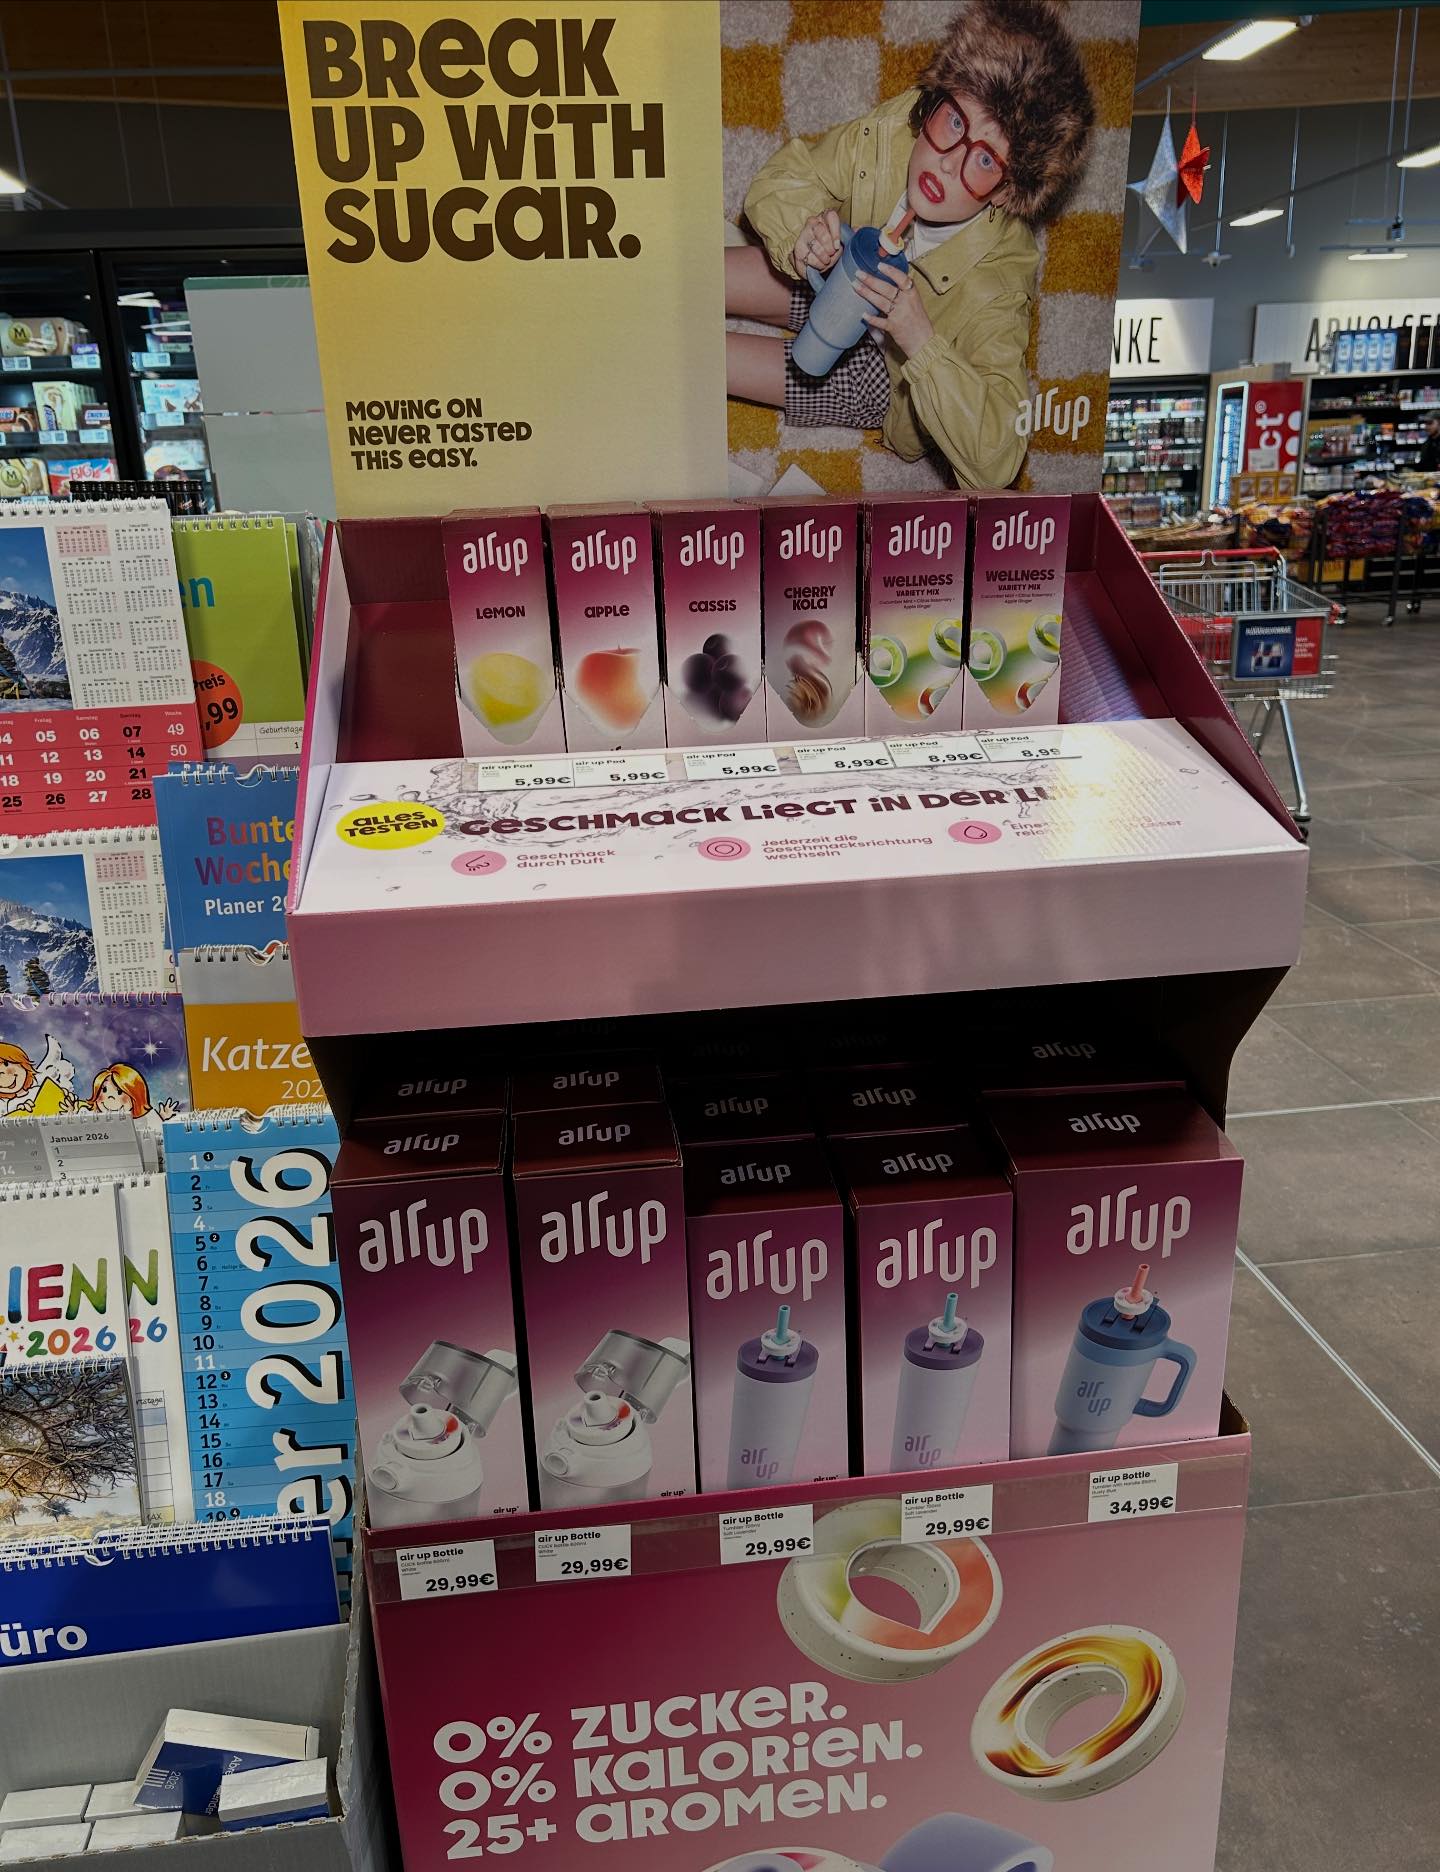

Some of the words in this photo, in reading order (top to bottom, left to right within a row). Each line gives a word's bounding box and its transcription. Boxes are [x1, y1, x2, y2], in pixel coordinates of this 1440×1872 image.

[312, 105, 425, 183] UP
[447, 397, 483, 418] ON
[35, 731, 57, 743] 05
[79, 728, 100, 740] 06
[122, 726, 142, 738] 07
[167, 723, 185, 736] 49
[40, 752, 60, 764] 12
[84, 749, 103, 761] 13
[127, 747, 146, 759] 14
[170, 744, 188, 756] 50
[928, 752, 983, 763] 8,99€
[722, 764, 777, 775] 5,99€
[834, 759, 889, 769] 8,99€
[0, 775, 20, 787] 18
[43, 772, 63, 784] 19
[85, 770, 106, 782] 20
[129, 768, 147, 779] 21
[515, 776, 571, 787] 5,99€
[609, 771, 666, 782] 5,99€
[2, 796, 22, 808] 25
[45, 793, 66, 805] 26
[88, 791, 108, 803] 27
[131, 789, 152, 800] 28
[761, 836, 830, 848] Jederzeit
[837, 834, 859, 843] die
[763, 836, 933, 854] Geschmacksrichtung
[517, 848, 616, 861] Geschmack
[517, 859, 566, 869] durch
[571, 856, 605, 867] Duft
[765, 849, 841, 862] wechseln
[205, 898, 264, 917] Planer
[202, 1036, 312, 1072] Katze
[50, 1134, 83, 1143] Januar
[85, 1132, 109, 1141] 2026
[1, 1165, 15, 1175] 14
[189, 1154, 199, 1170] 1
[191, 1175, 201, 1191] 2
[192, 1196, 202, 1211] 3
[193, 1215, 206, 1232] 4
[196, 1235, 206, 1251] 5
[197, 1255, 208, 1271] 6
[199, 1275, 208, 1291] 7
[200, 1295, 211, 1311] 8
[202, 1315, 212, 1331] 9
[26, 1325, 117, 1358] 2026
[193, 1335, 215, 1350] 10
[194, 1354, 216, 1370] 11
[196, 1374, 217, 1389] 12
[198, 1394, 219, 1409] 13
[199, 1413, 220, 1429] 14
[200, 1433, 222, 1448] 15
[202, 1453, 223, 1468] 16
[203, 1472, 224, 1488] 17
[1092, 1475, 1105, 1484] air
[1108, 1474, 1121, 1483] up
[1122, 1471, 1151, 1480] Bottle
[204, 1491, 226, 1507] 18
[661, 1489, 671, 1497] air
[905, 1497, 919, 1505] air
[920, 1496, 933, 1504] up
[935, 1492, 964, 1502] Bottle
[493, 1506, 505, 1514] air
[1109, 1496, 1174, 1514] 34,99€
[723, 1517, 737, 1525] air
[739, 1516, 752, 1524] up
[754, 1511, 784, 1521] Bottle
[926, 1517, 990, 1536] 29,99€
[554, 1535, 568, 1543] up
[570, 1531, 601, 1540] Bottle
[400, 1552, 414, 1561] air
[416, 1552, 431, 1560] up
[433, 1548, 464, 1558] Bottle
[746, 1537, 811, 1556] 29,99€
[561, 1558, 628, 1575] 29,99€
[426, 1573, 495, 1592] 29,99€
[0, 1623, 87, 1657] üro
[433, 1712, 553, 1764] 0%
[438, 1762, 557, 1812] 0%
[442, 1812, 557, 1861] 25+
